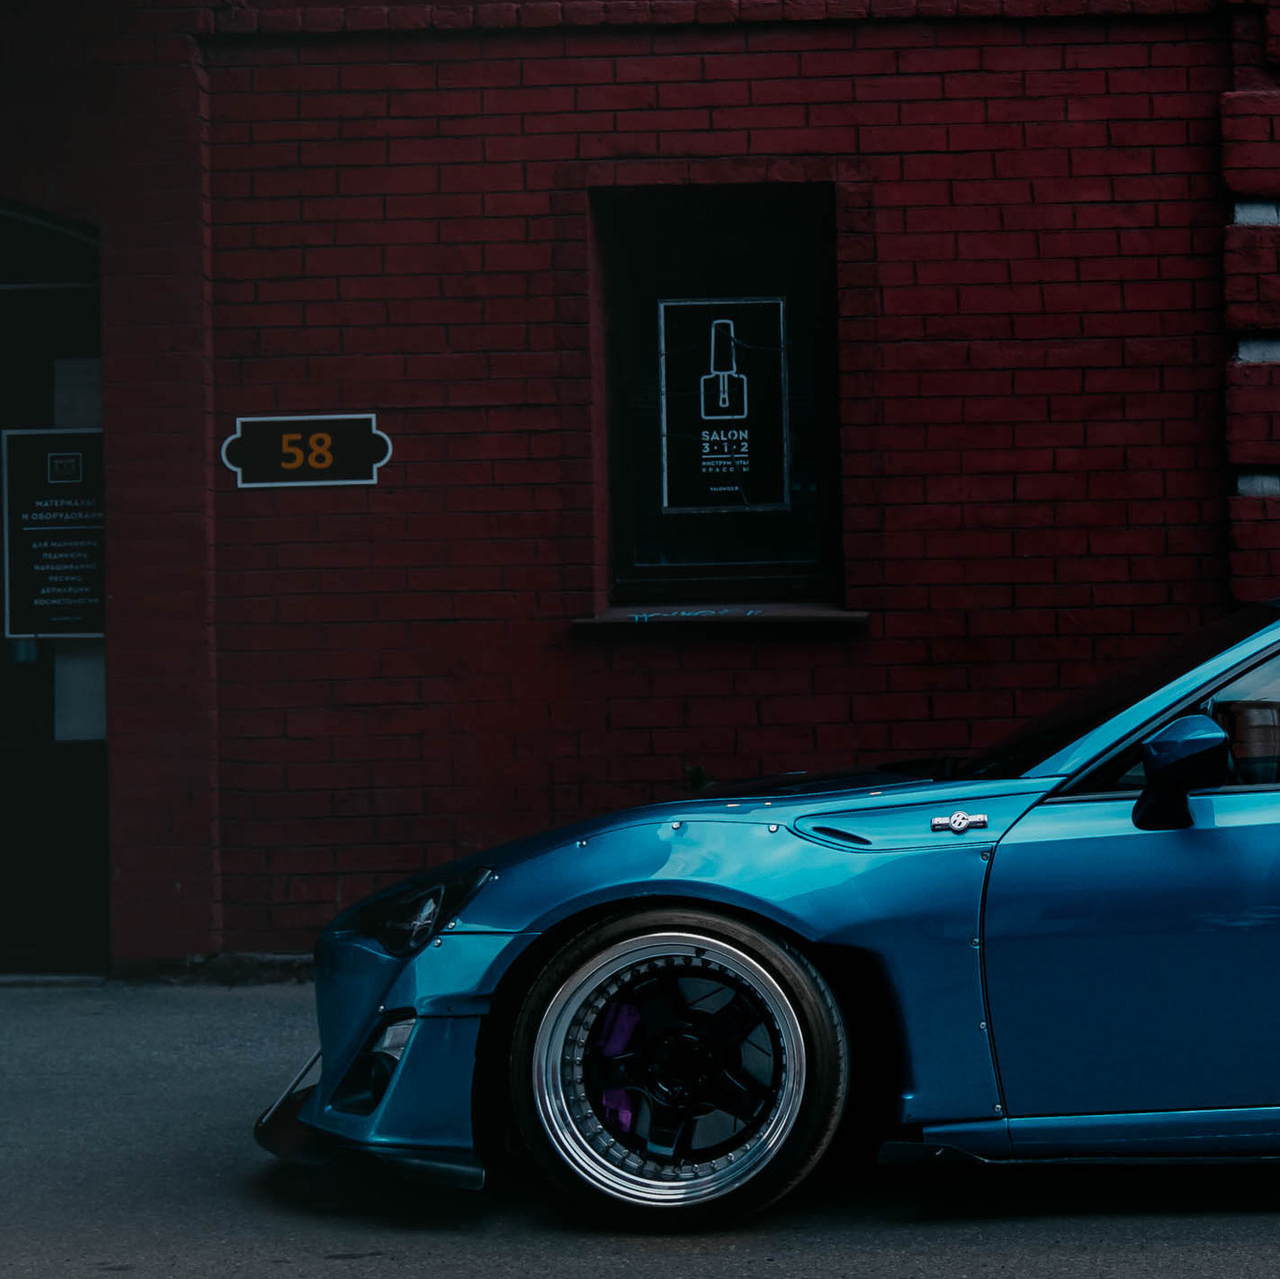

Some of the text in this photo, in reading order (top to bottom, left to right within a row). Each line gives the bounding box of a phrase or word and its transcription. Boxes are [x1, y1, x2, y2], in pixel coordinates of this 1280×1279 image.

[701, 429, 749, 441] SALON
[281, 432, 334, 470] 58
[31, 511, 104, 520] ОБОРУДОВАНИ
